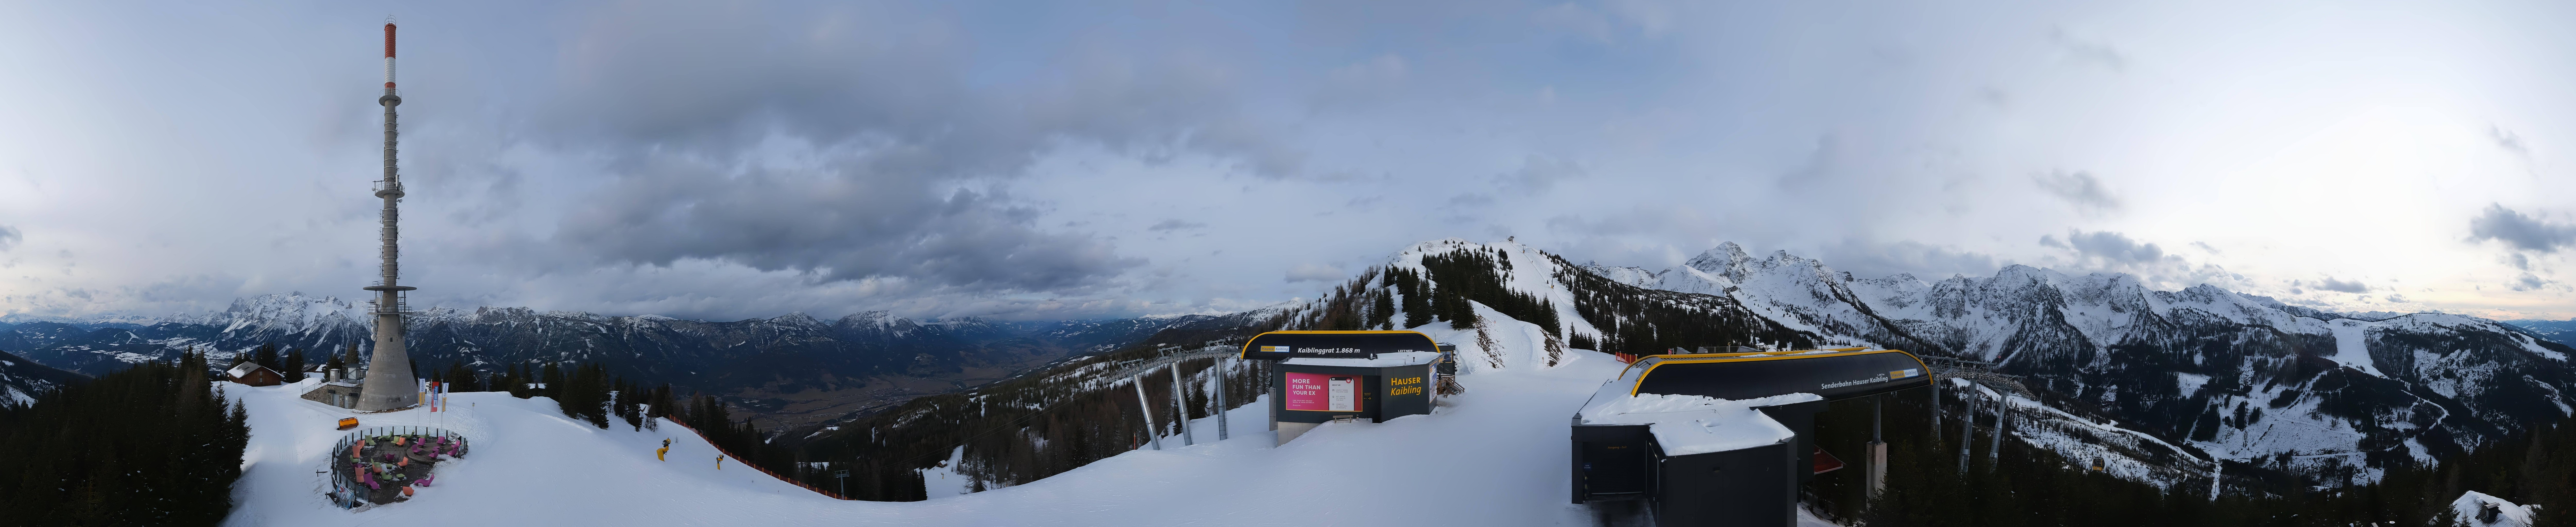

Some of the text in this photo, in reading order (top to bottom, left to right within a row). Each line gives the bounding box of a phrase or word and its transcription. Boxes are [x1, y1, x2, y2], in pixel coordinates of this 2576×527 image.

[1391, 377, 1421, 386] HAUSER
[1821, 381, 1852, 389] Senderbahn
[1391, 386, 1421, 396] Kaibling
